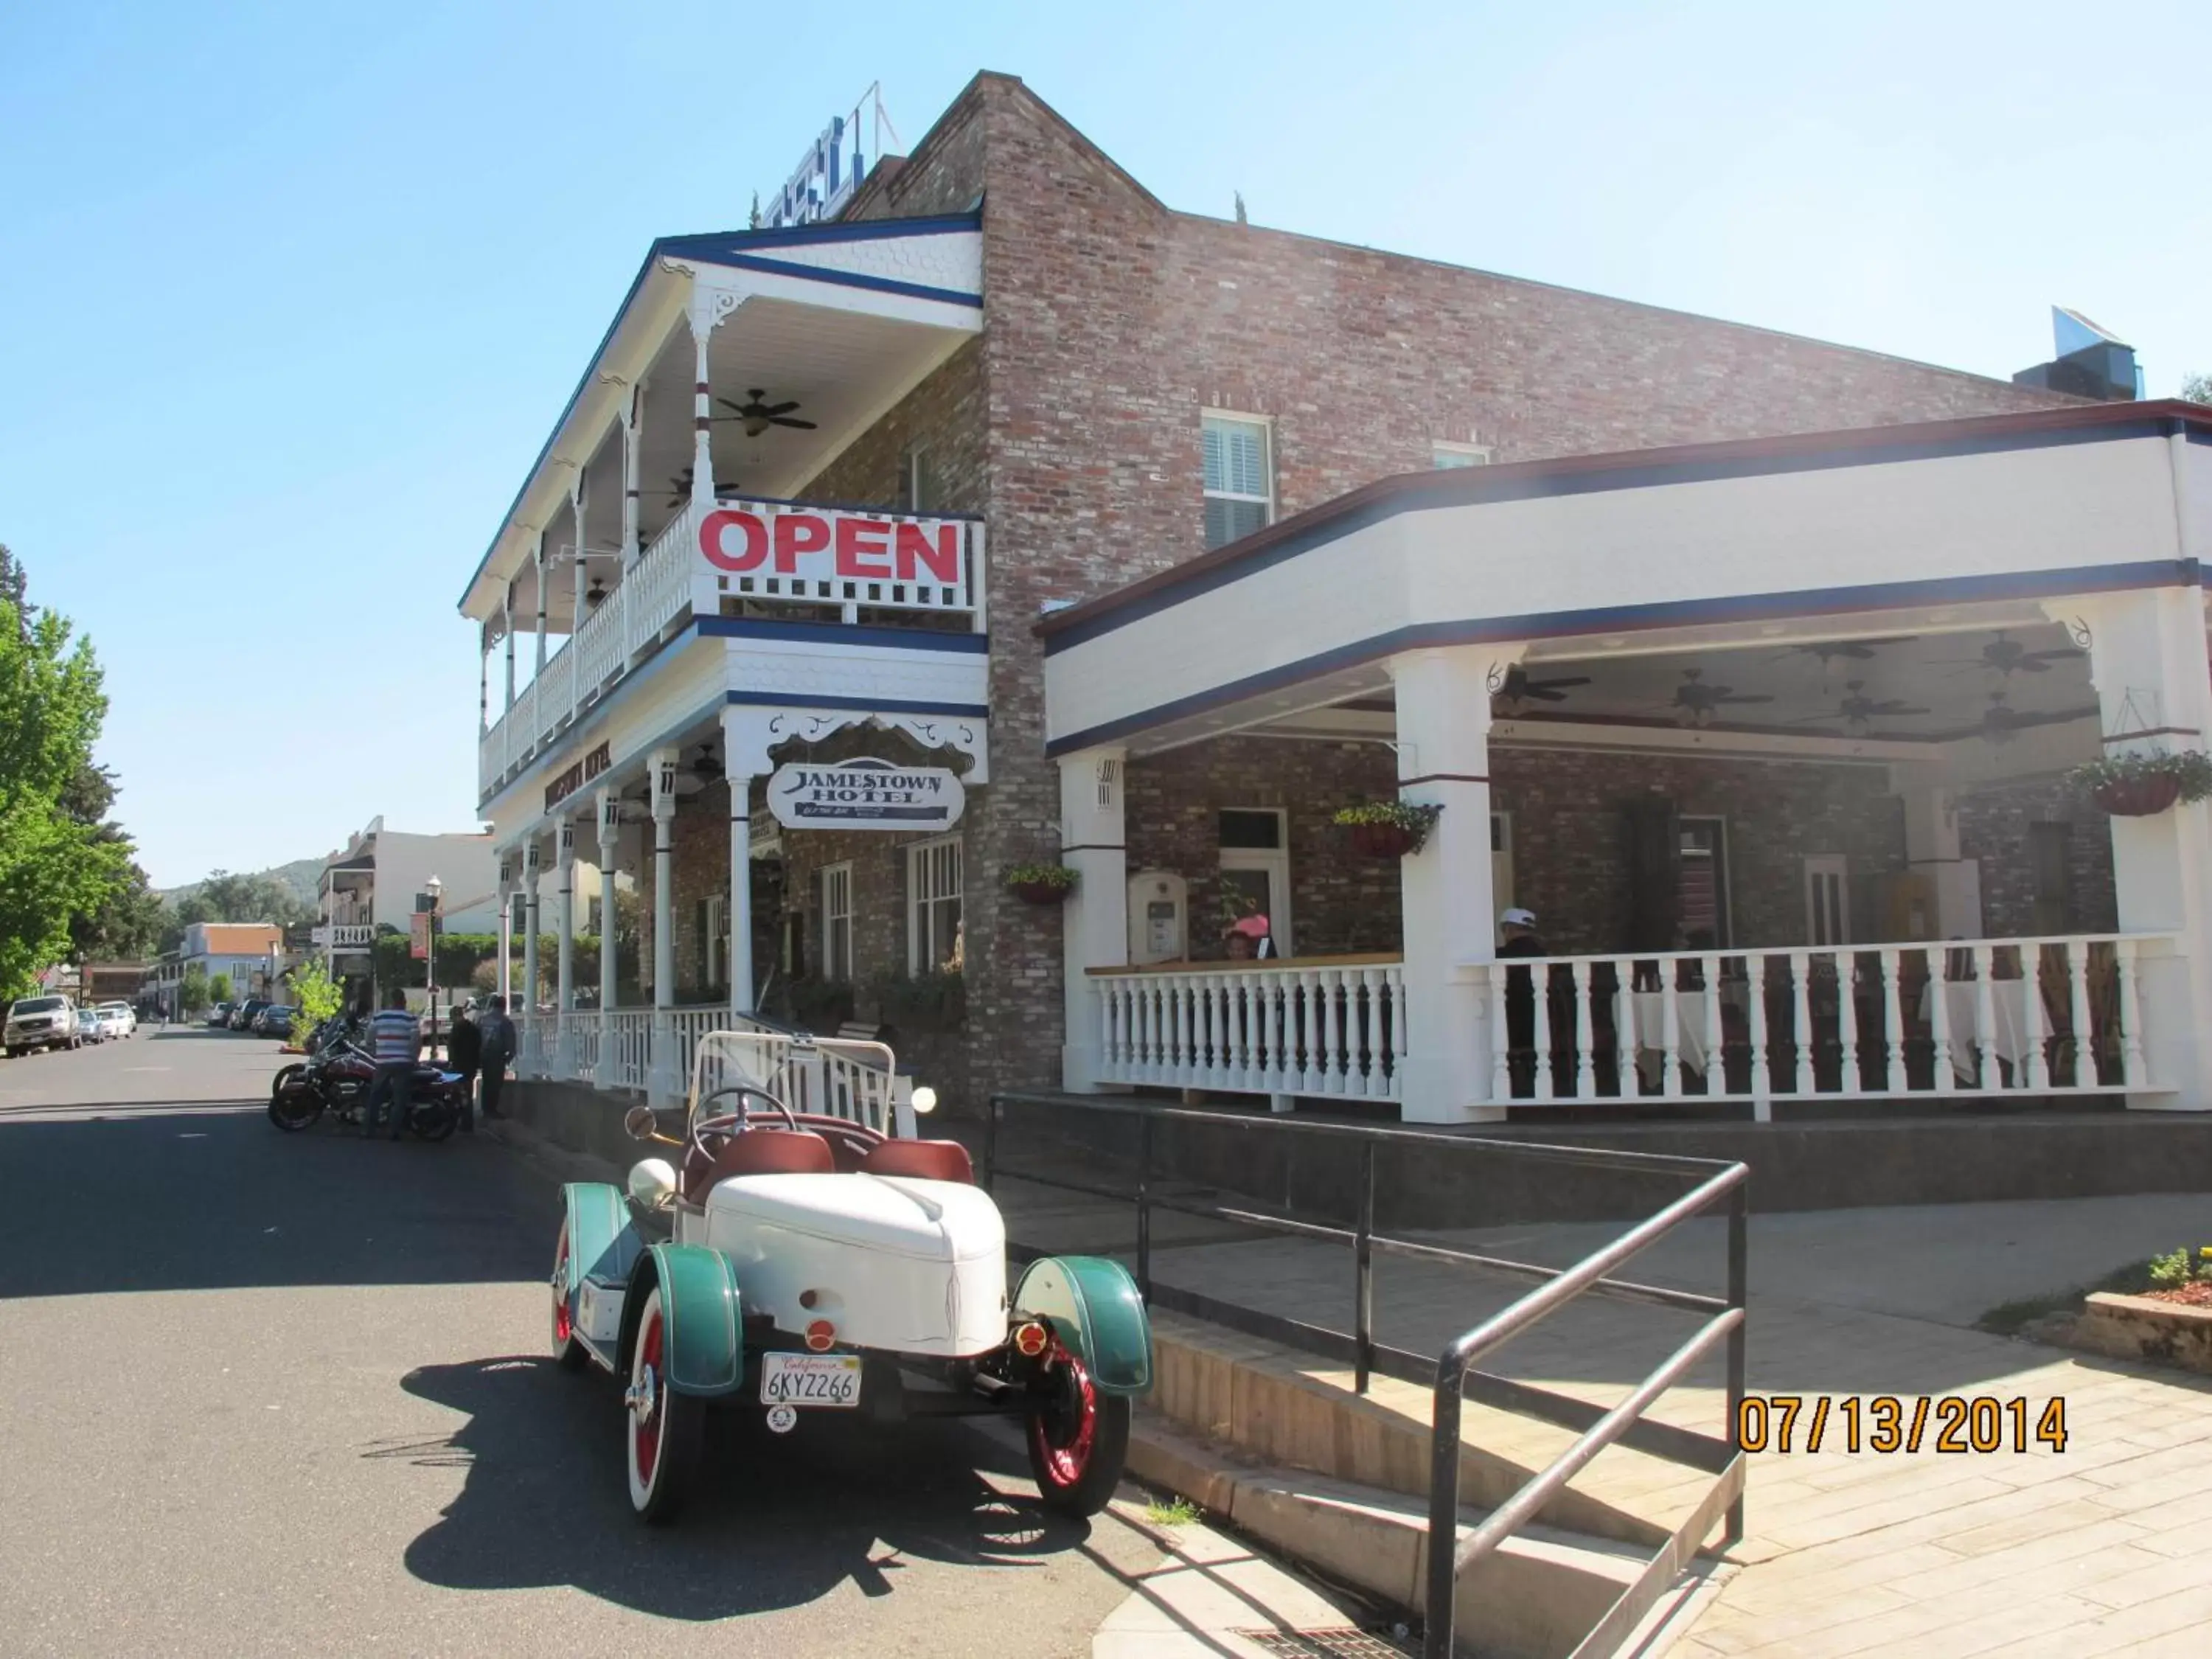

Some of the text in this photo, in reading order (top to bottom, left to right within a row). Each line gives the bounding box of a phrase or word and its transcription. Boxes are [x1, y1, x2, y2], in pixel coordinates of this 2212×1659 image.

[699, 509, 959, 583] OPEN
[782, 771, 942, 795] JAMESTOWN
[812, 789, 922, 804] HOTEL
[784, 1359, 844, 1372] California
[768, 1372, 852, 1398] 6KYZ266
